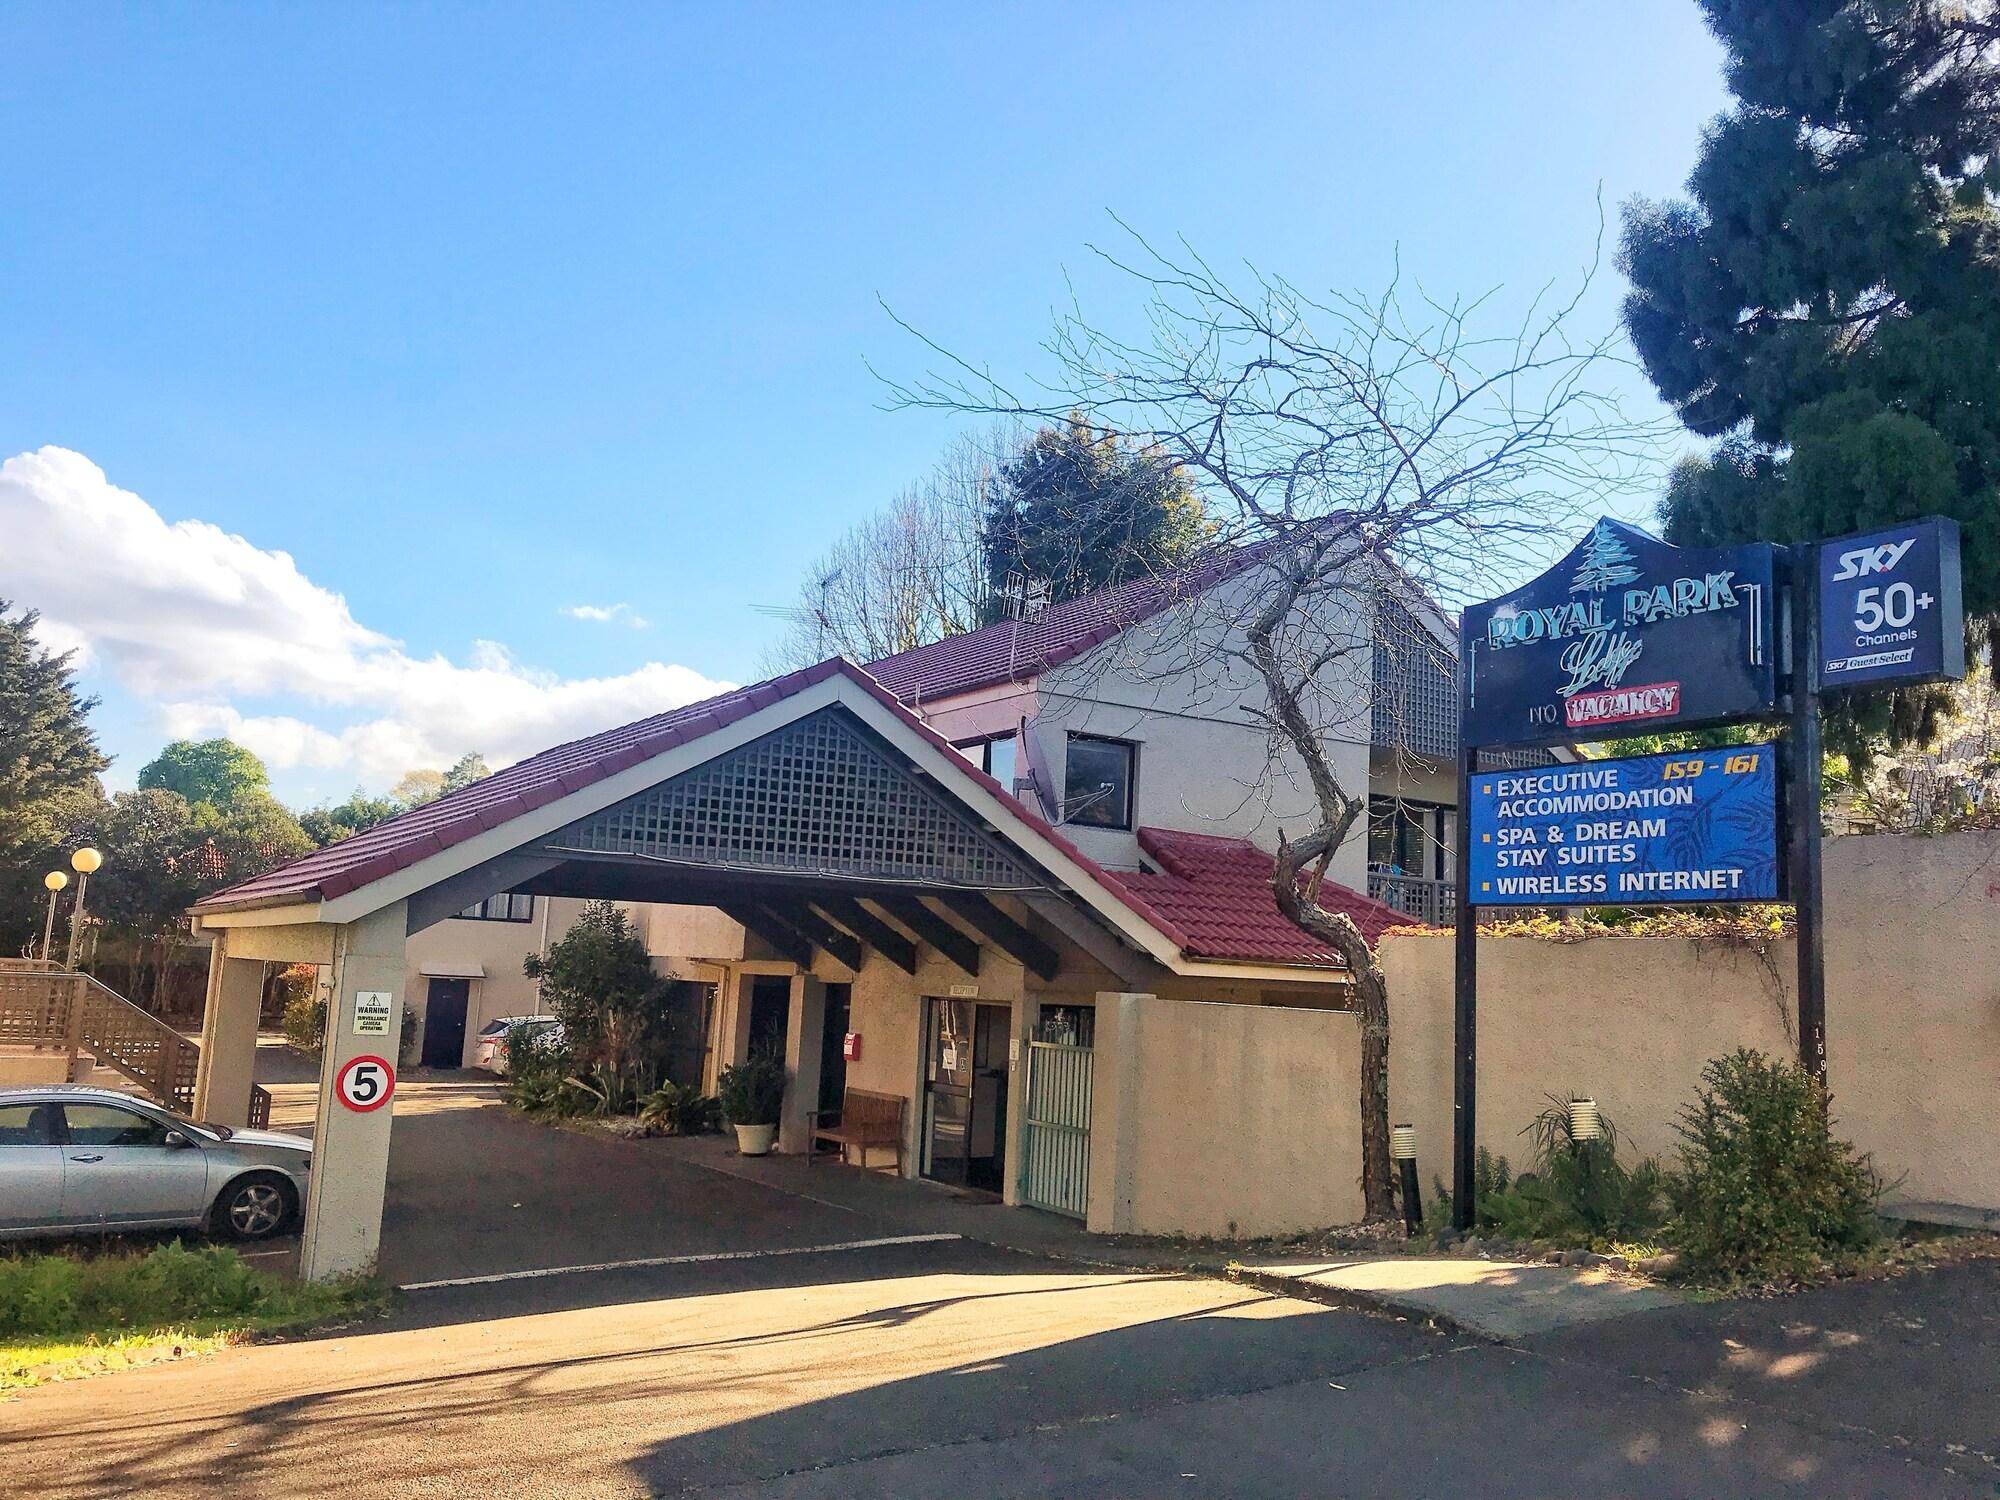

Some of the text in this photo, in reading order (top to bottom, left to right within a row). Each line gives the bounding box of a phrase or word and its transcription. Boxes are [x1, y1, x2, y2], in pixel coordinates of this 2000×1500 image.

[1832, 538, 1917, 582] SKY
[1488, 570, 1740, 650] ROYAL PARK
[1854, 581, 1934, 633] 50+
[1855, 628, 1918, 648] Channels
[1849, 655, 1878, 668] Guest
[1879, 651, 1909, 666] Select
[1529, 686, 1678, 724] NO VACANCY
[1663, 760, 1704, 780] 159
[1724, 754, 1760, 775] 161
[1496, 769, 1618, 797] EXECUTIVE
[1497, 786, 1693, 819] ACCOMMODATION
[1496, 818, 1666, 846] SPA & DREAM
[1496, 843, 1636, 868] STAY SUITES
[1496, 869, 1743, 896] WIRELESS INTERNET
[357, 1006, 389, 1014] WARNING
[352, 1066, 378, 1102] 5
